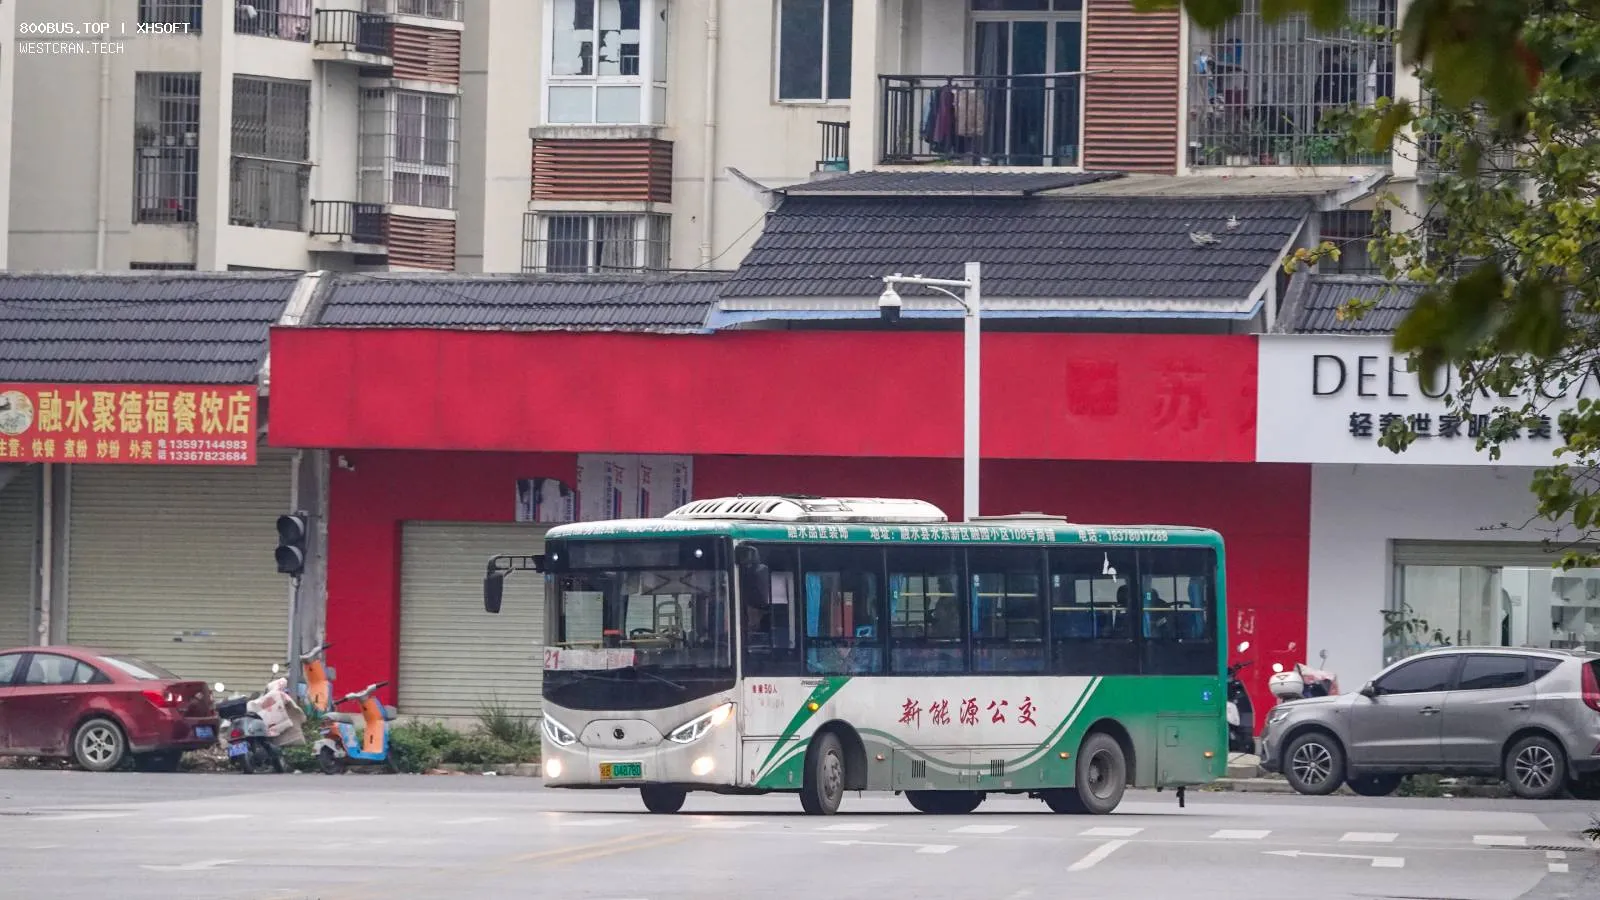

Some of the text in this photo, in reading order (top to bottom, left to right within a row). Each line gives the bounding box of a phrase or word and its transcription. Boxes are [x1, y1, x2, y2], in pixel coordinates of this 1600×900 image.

[37, 389, 251, 434] 融水聚德福餐饮店
[32, 438, 55, 458] 快餐
[64, 438, 88, 459] 煮粉
[129, 440, 153, 459] 外卖
[169, 439, 248, 450] 13597144983
[169, 451, 248, 461] 13367823684
[898, 696, 1037, 730] 新能源公交
